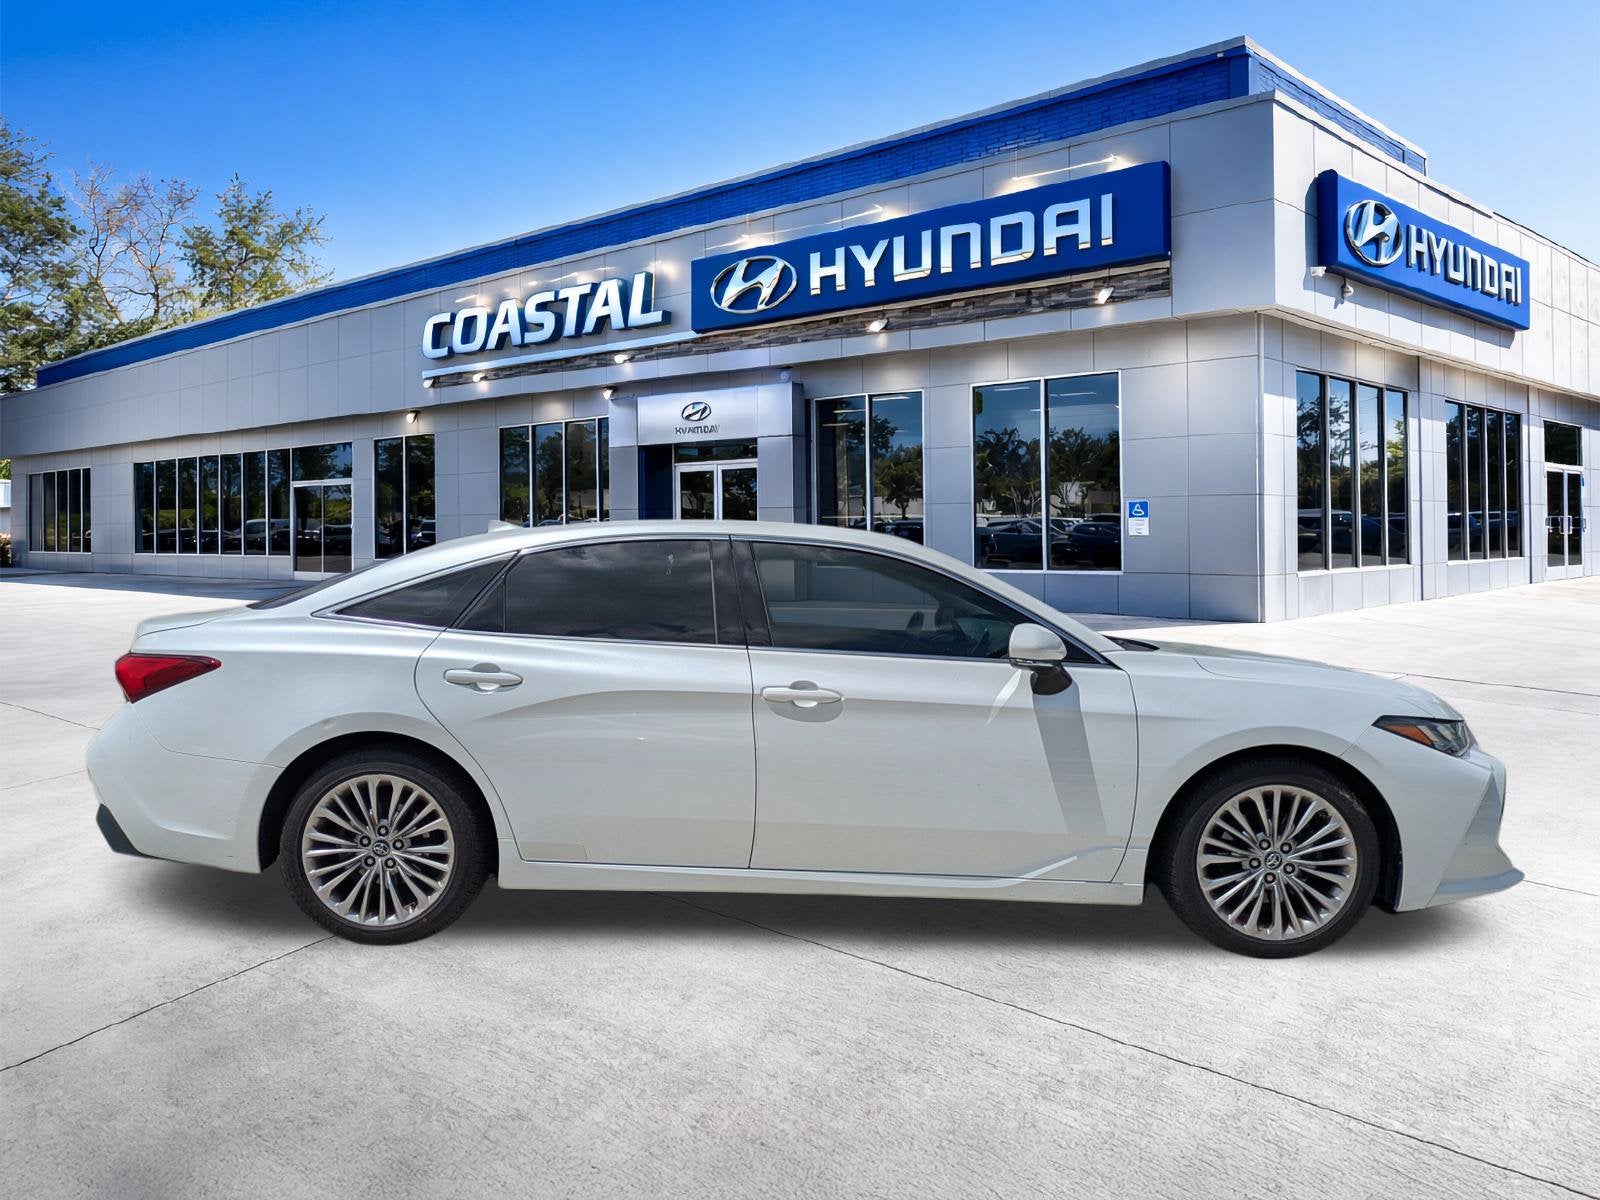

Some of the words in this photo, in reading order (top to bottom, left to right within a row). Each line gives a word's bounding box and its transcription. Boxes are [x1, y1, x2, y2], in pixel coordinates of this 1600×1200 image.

[808, 193, 1114, 295] HYUNDAI
[1406, 224, 1522, 306] HYUNDAI
[422, 271, 668, 359] COASTAL
